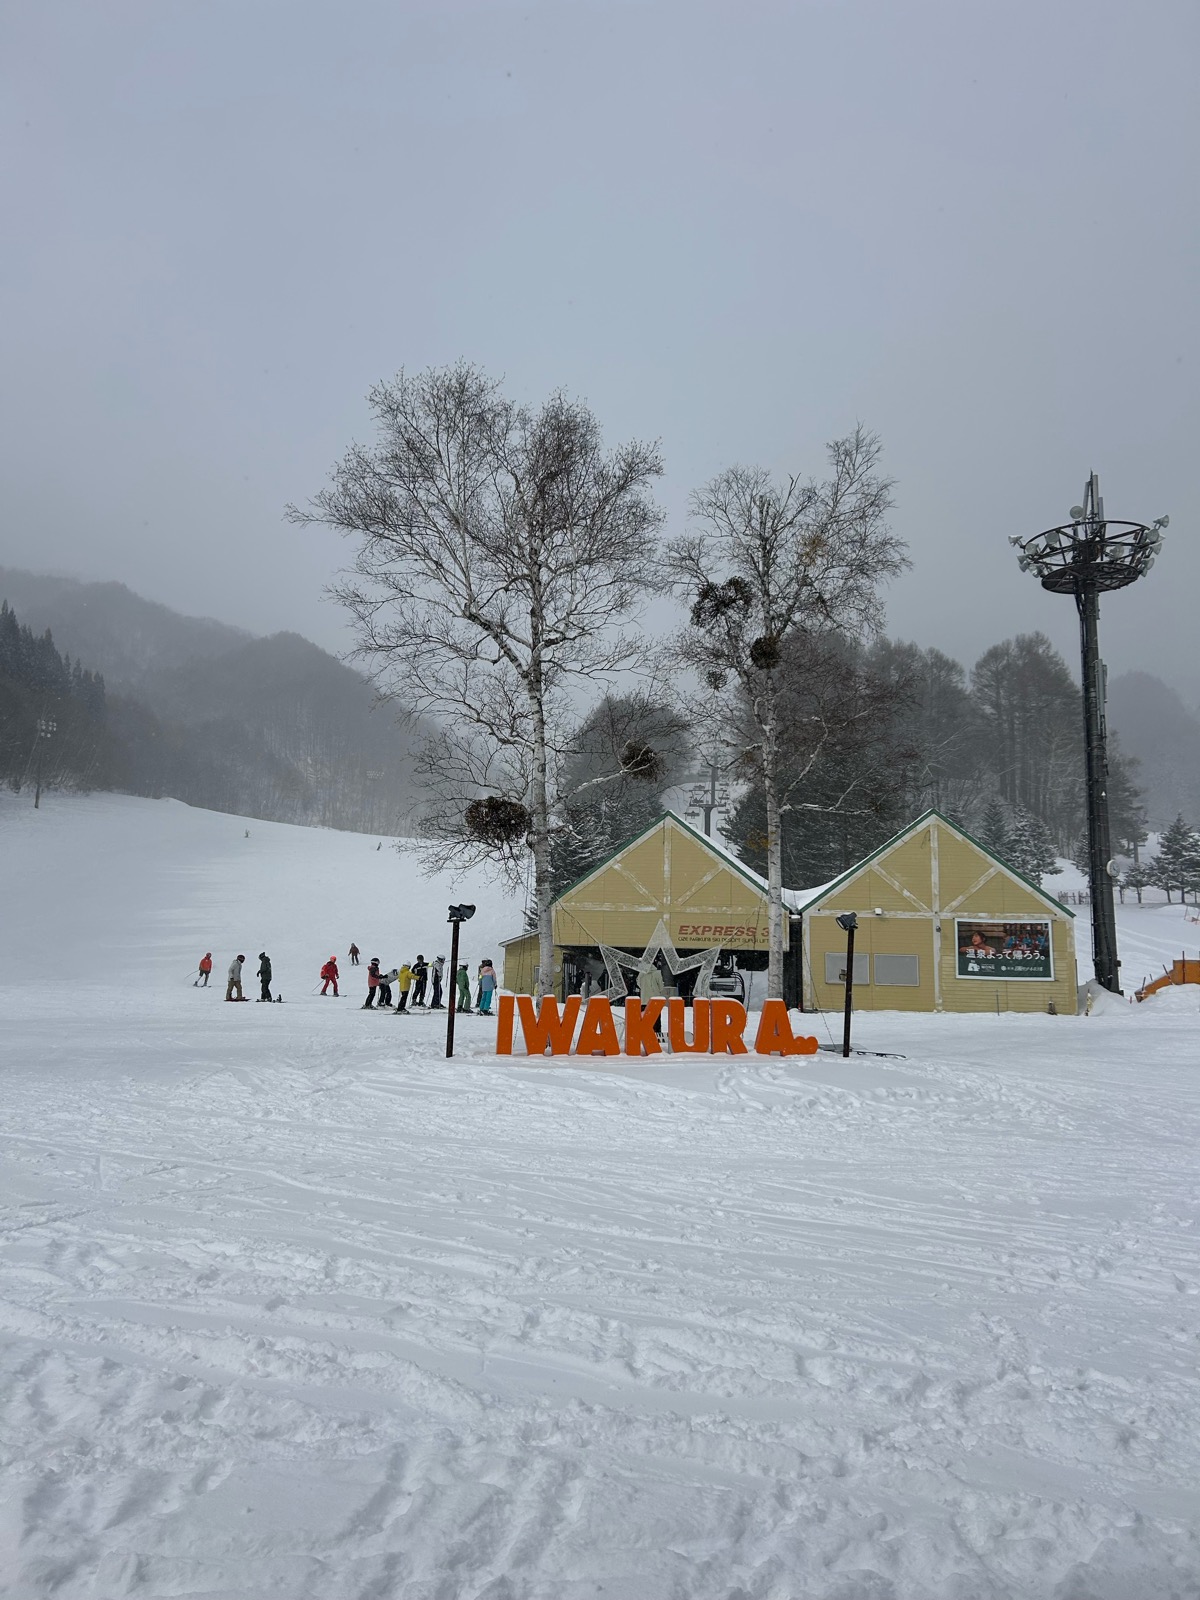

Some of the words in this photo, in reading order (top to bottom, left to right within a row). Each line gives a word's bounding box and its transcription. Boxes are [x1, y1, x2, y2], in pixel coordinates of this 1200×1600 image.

[678, 925, 756, 937] EXPRESS
[966, 949, 1045, 960] 温泉よって帰ろう。
[496, 995, 796, 1056] IWAKURA
